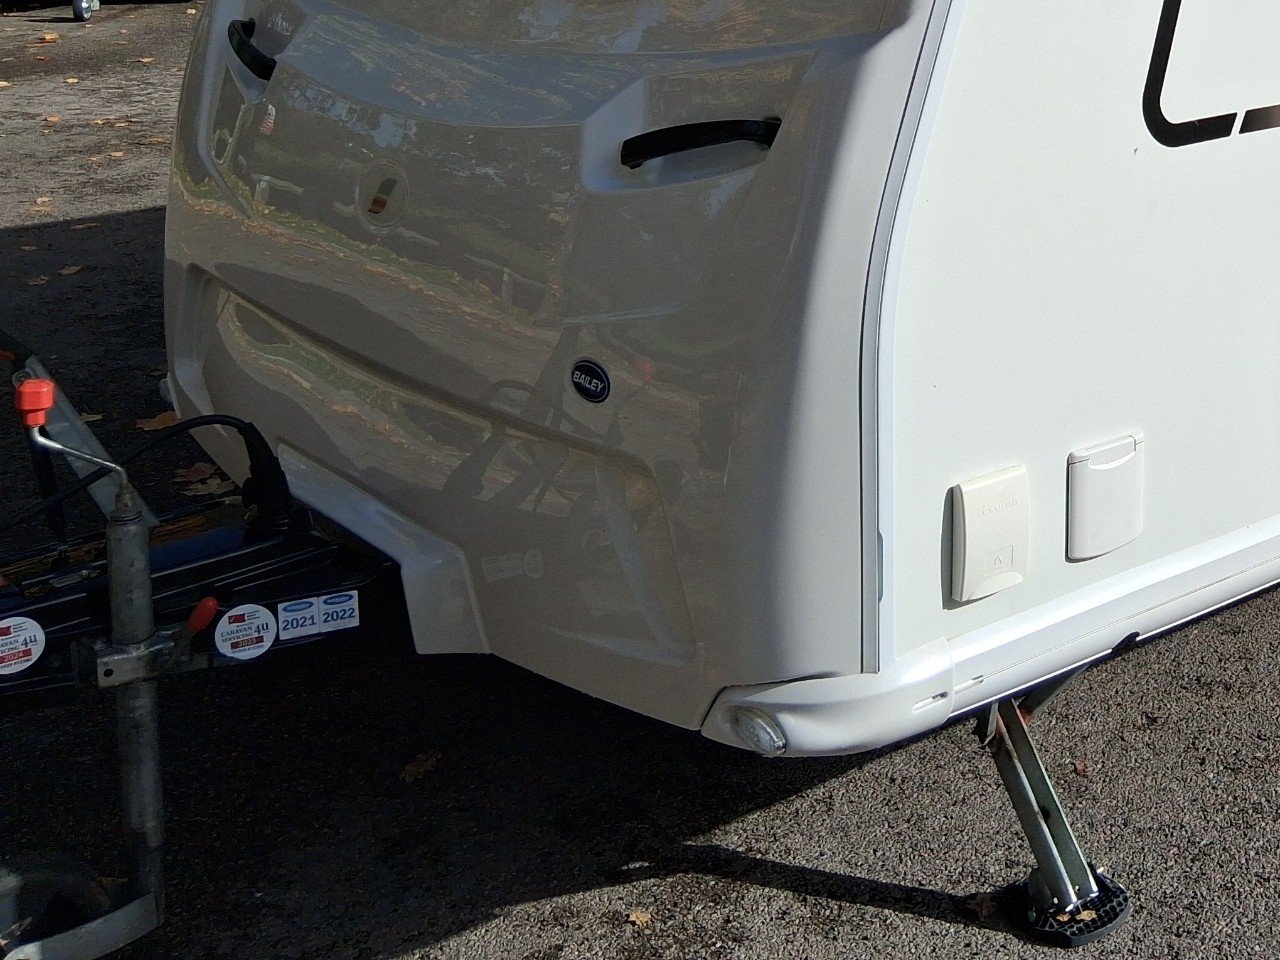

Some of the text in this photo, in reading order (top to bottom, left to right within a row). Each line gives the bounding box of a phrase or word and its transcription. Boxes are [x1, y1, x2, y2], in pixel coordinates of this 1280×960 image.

[572, 370, 605, 392] BAILEY
[282, 614, 317, 631] 2021
[322, 607, 356, 623] 2022
[221, 626, 252, 638] CARAVAN
